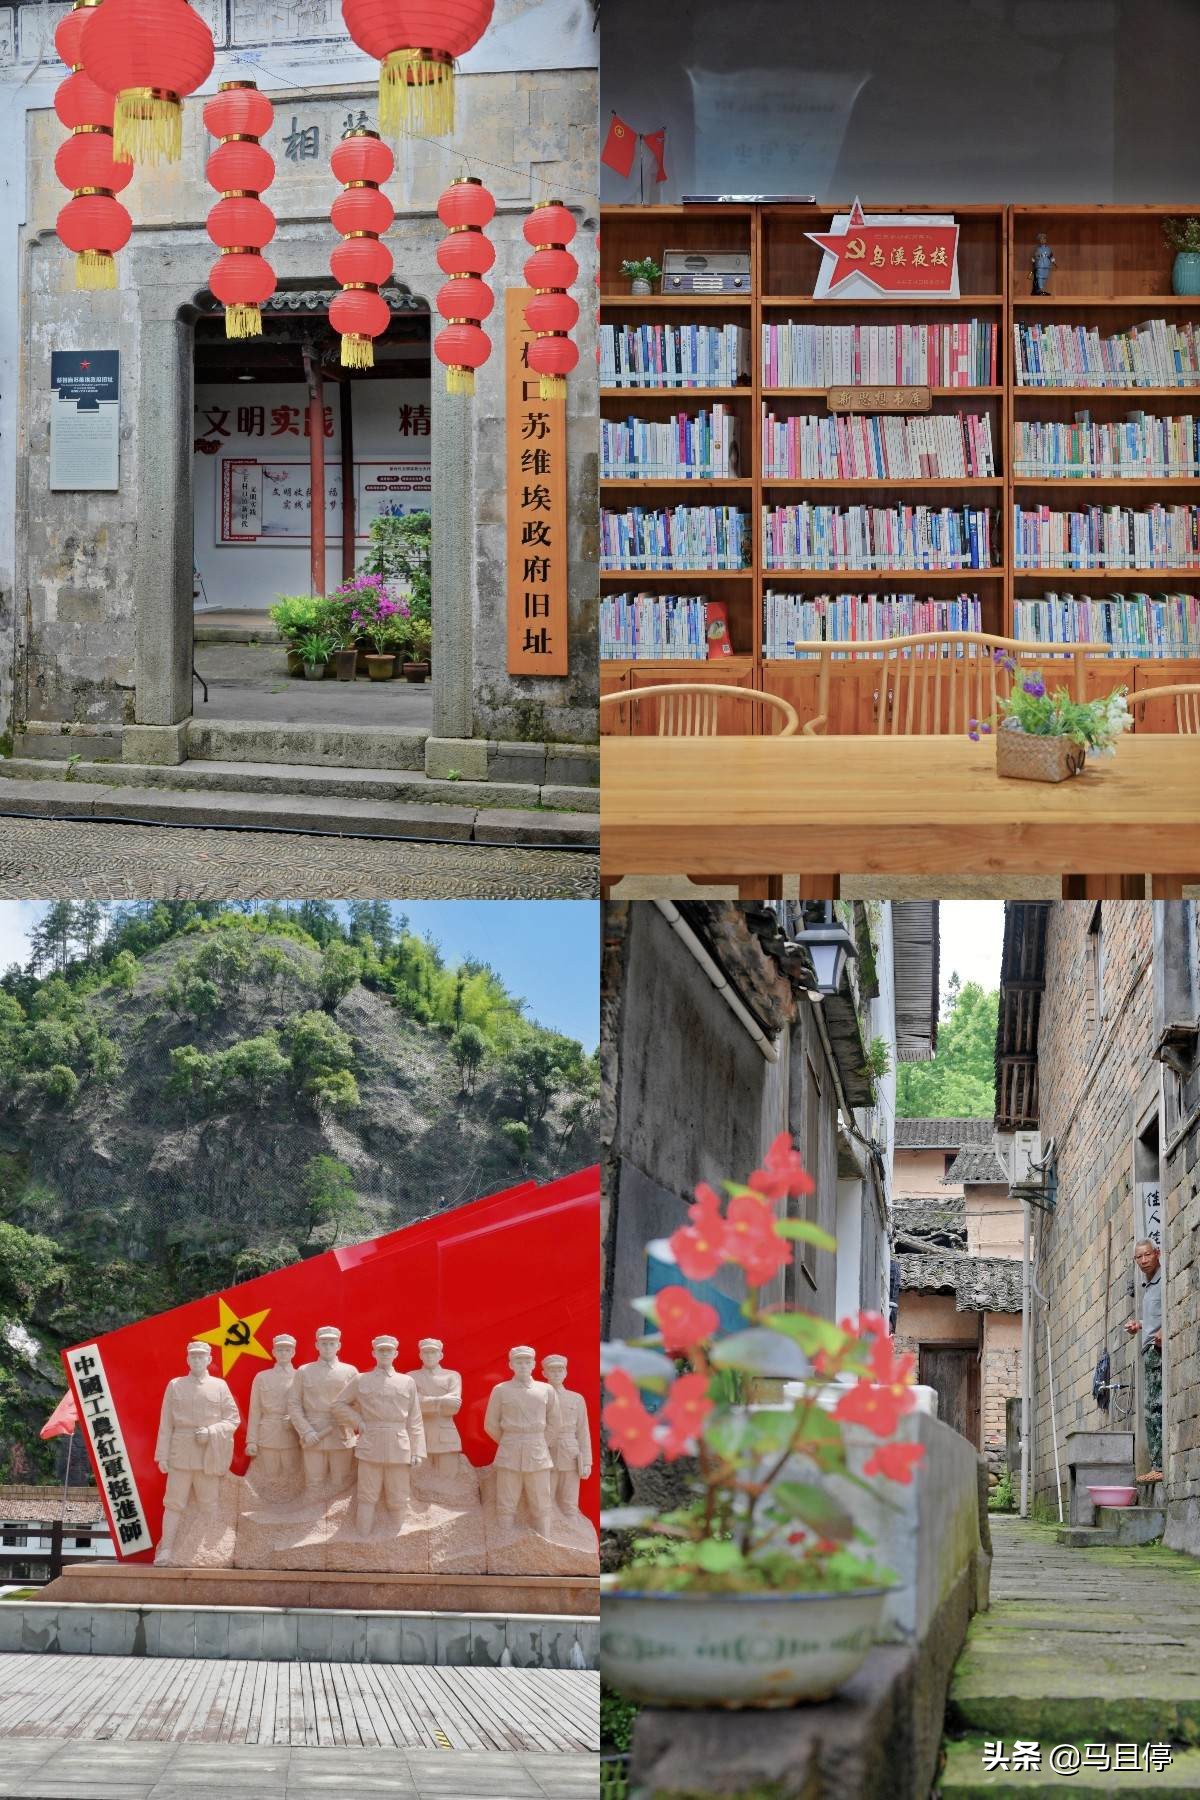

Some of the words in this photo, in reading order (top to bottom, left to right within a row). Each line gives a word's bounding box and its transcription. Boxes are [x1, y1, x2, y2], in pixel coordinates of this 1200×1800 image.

[399, 403, 431, 437] 精
[838, 391, 922, 407] 新思想书库
[519, 309, 553, 655] 口苏维埃政府旧址
[73, 1354, 144, 1546] 中國工農紅軍挺進師
